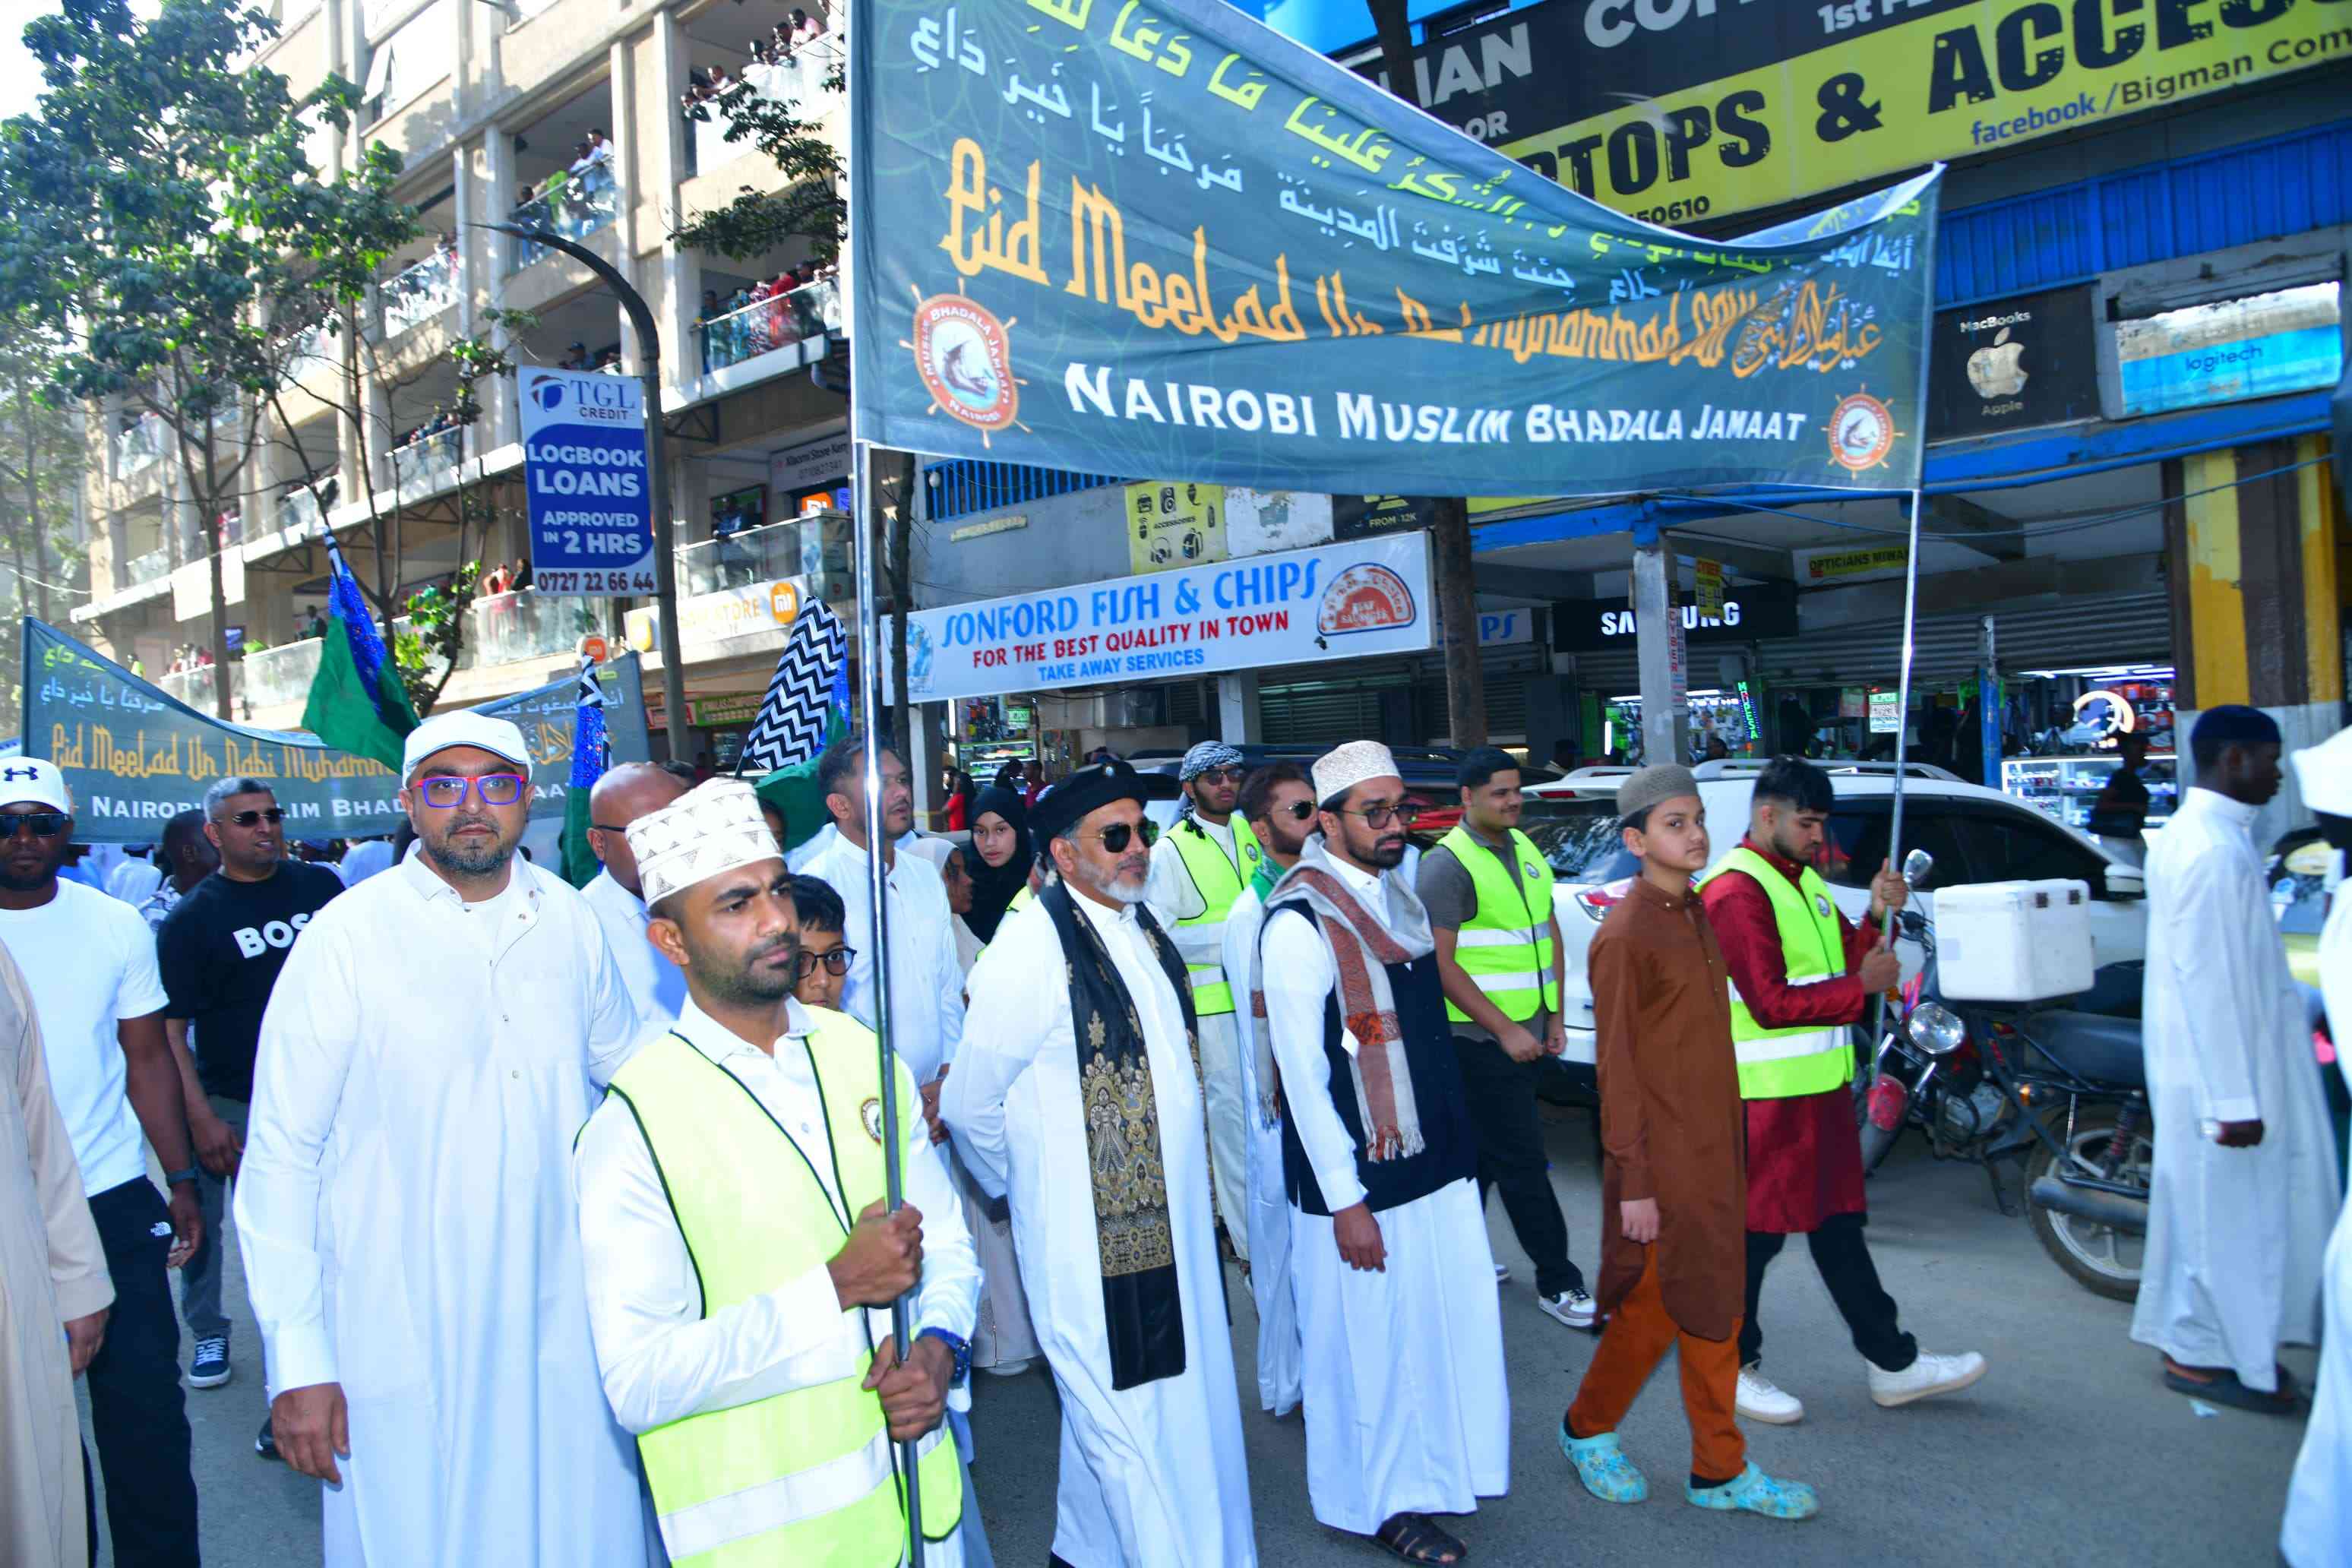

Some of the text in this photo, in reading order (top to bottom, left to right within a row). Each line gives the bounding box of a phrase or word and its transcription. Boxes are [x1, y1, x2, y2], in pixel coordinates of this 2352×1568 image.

[1816, 73, 1883, 142] &
[938, 138, 1051, 286] Eid
[1626, 196, 1710, 227] 50610
[931, 306, 991, 335] BHADALA
[1960, 311, 2031, 333] MacBooks
[2185, 345, 2263, 372] logitech
[571, 379, 636, 409] TGL
[1064, 362, 1317, 437] NAIROBI
[1336, 391, 1512, 444] MUSLIM
[1525, 403, 1684, 442] BHADALA
[1690, 404, 1807, 441] JAMAAT
[579, 406, 628, 420] CREDIT
[1981, 401, 2024, 416] Apple
[527, 444, 644, 467] LOGBOOK
[536, 469, 640, 498] LOANS
[542, 511, 639, 527] APPROVED
[1152, 515, 1197, 530] ACCESSORIES
[1369, 513, 1418, 529] FROM 12K
[543, 531, 642, 555] IN 2 HRS
[1810, 553, 1870, 571] OPTICIANS
[538, 571, 655, 592] 0727 22 66 44
[942, 596, 1079, 648] SONFORD
[1092, 583, 1159, 627] FISH
[1174, 578, 1202, 615] &
[1213, 558, 1321, 609] CHIPS
[1601, 602, 1740, 635] SAUG
[972, 610, 1289, 669] FOR THE BEST QUALITY IN TOWN
[1038, 648, 1205, 681] TAKE AWAY SERVICES
[226, 737, 278, 779] Nabi
[92, 795, 201, 819] NAIROB
[332, 799, 408, 817] BHAD
